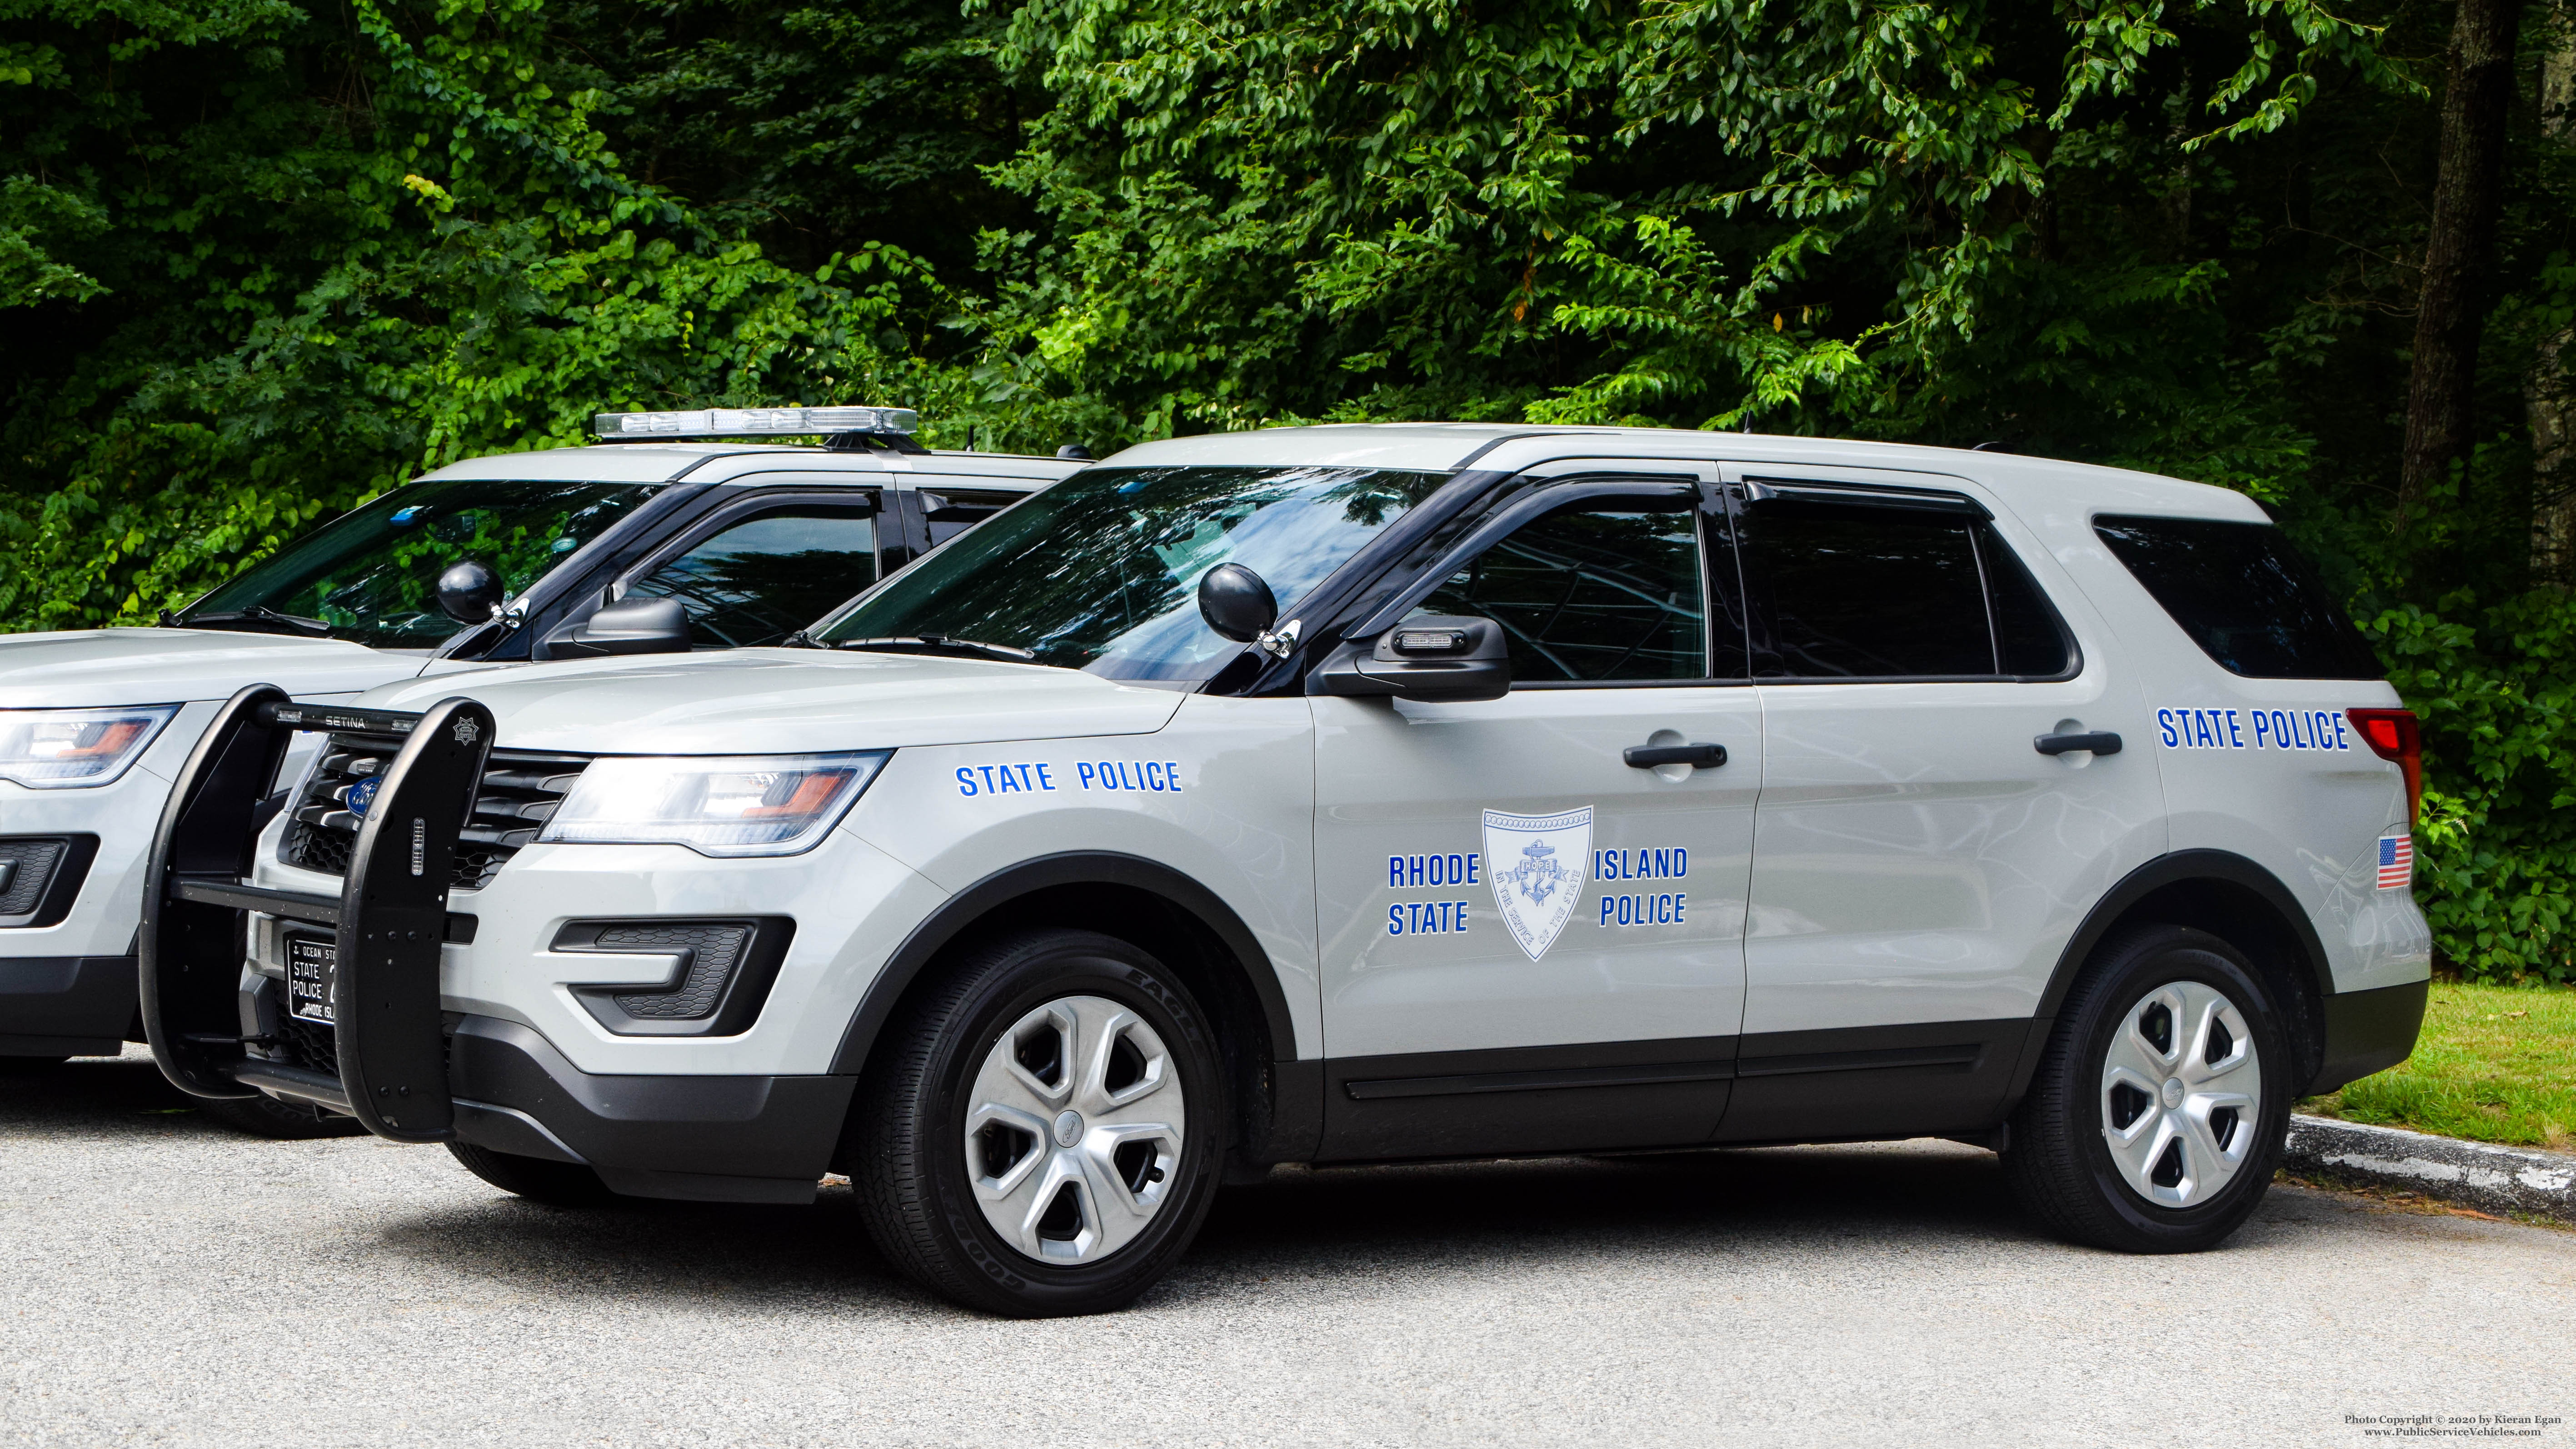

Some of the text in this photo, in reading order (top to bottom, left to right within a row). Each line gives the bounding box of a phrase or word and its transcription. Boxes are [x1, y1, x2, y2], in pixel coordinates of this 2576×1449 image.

[326, 716, 365, 729] SETINA
[2157, 707, 2348, 751] STATE POLICE
[956, 761, 1182, 797] STATE POLICE
[1389, 848, 1687, 888] RHODE ISLAND
[1525, 861, 1551, 870] HOPE
[1388, 894, 1686, 936] STATE POLICE
[1495, 869, 1581, 946] IN THE SERVICE OF THE STATE
[303, 946, 321, 959] OCEAN
[294, 961, 320, 979] STATE
[293, 980, 322, 999] POLICE
[305, 1003, 334, 1019] RHODE ISL
